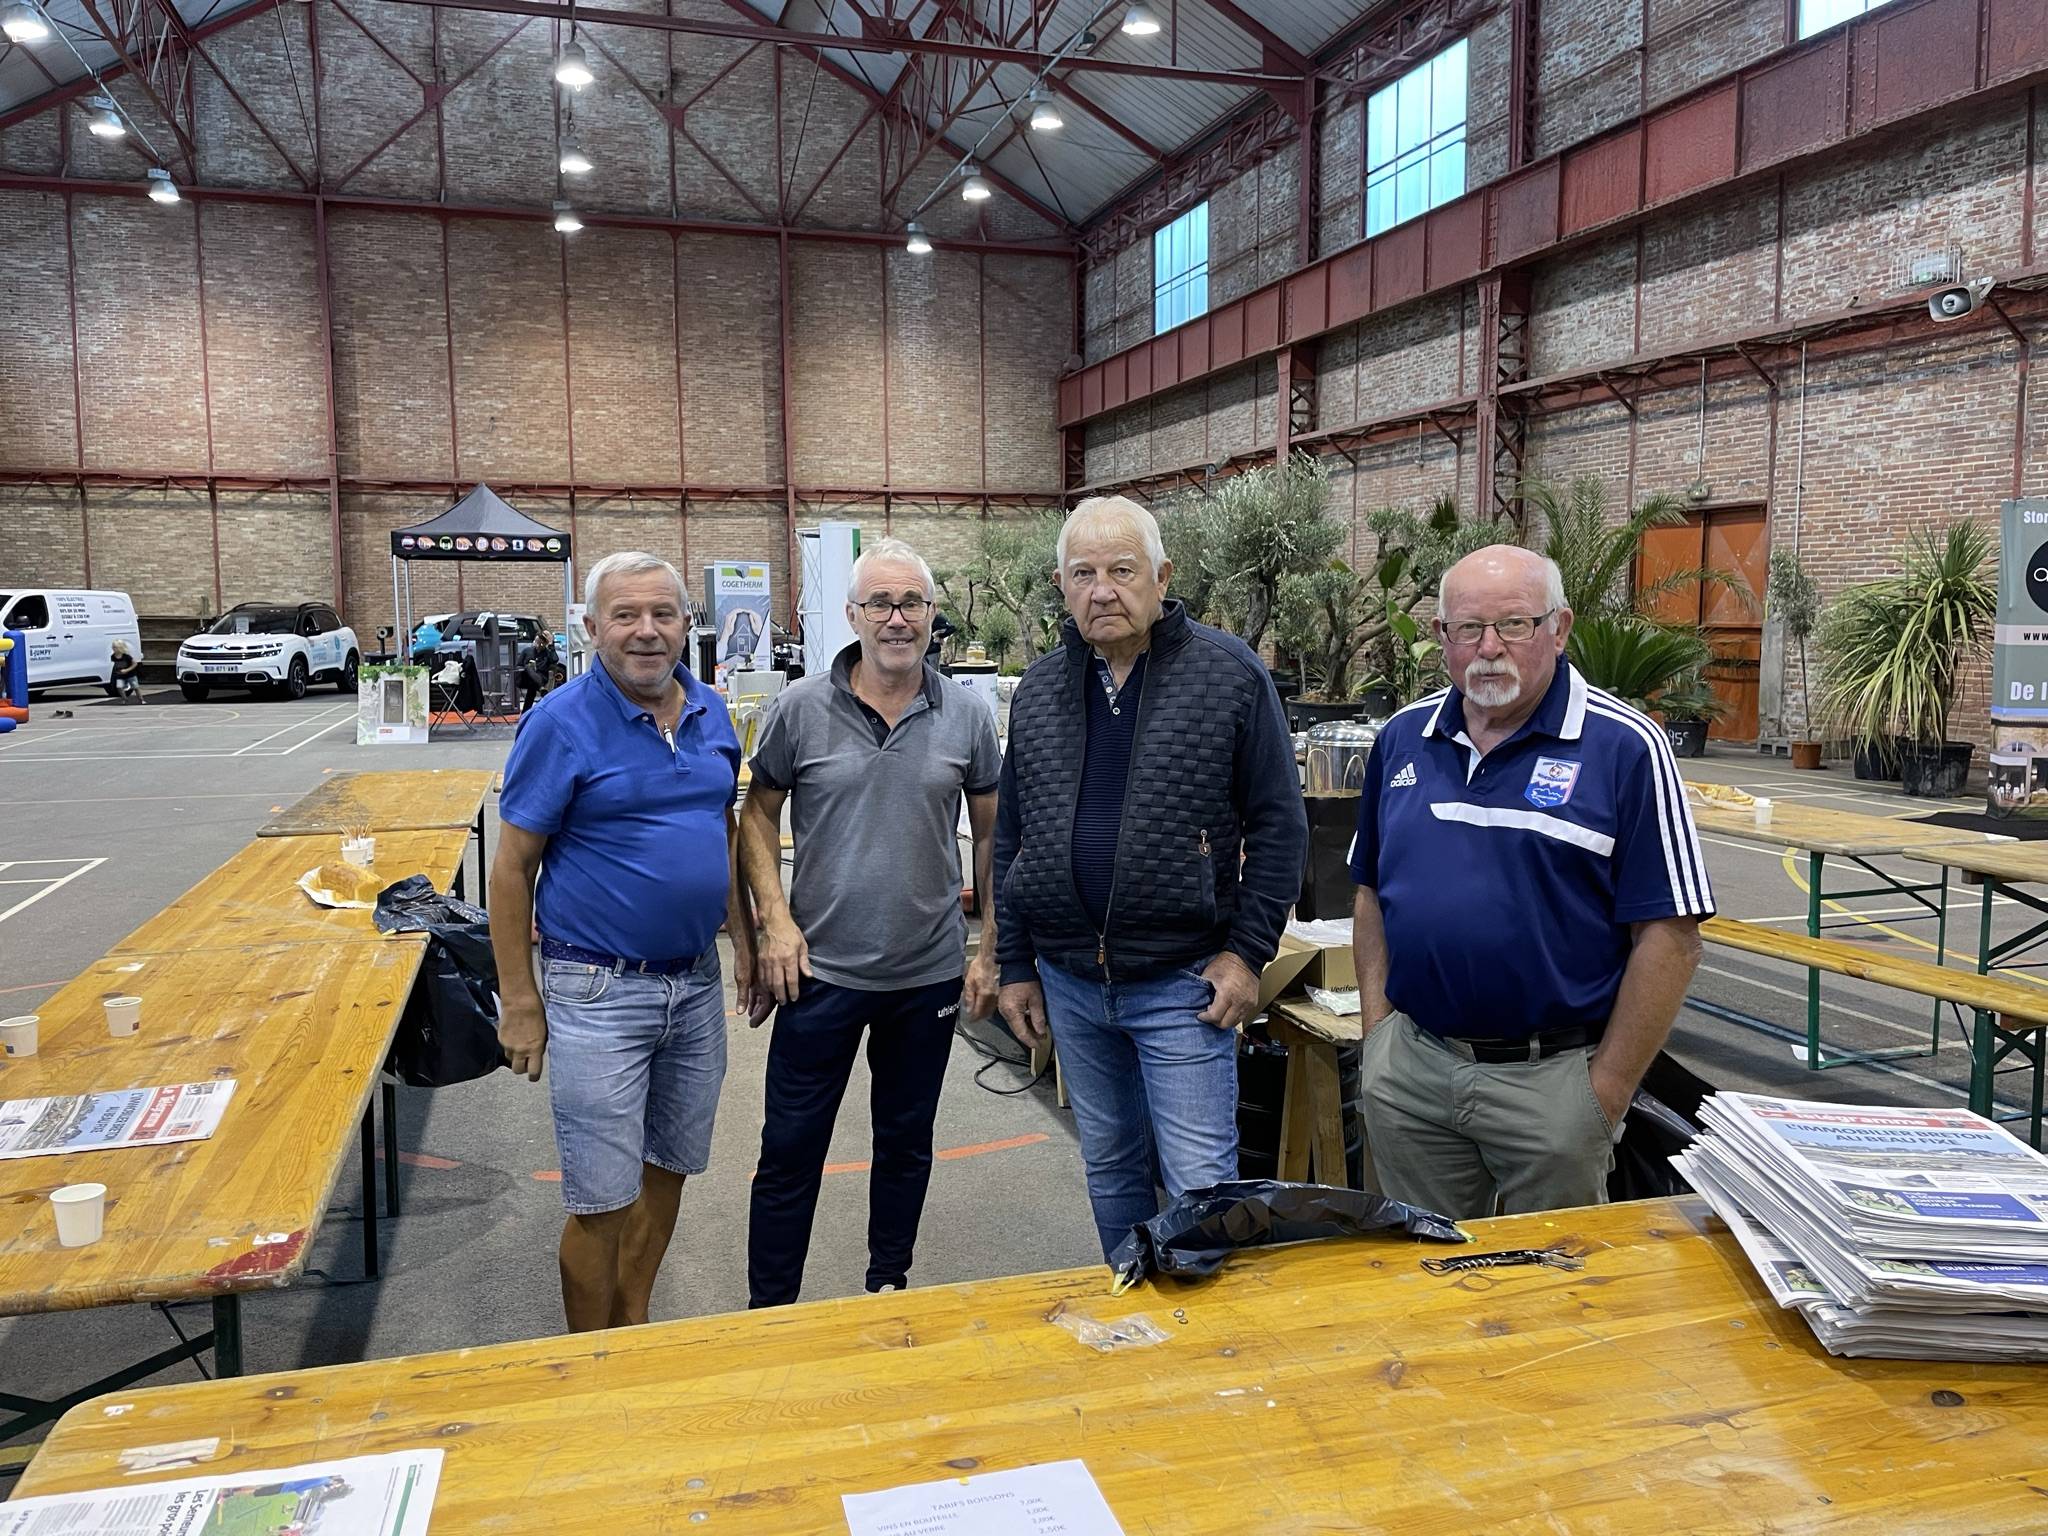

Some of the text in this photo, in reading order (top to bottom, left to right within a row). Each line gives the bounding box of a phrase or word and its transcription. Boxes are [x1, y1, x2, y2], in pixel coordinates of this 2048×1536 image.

[721, 580, 763, 589] COGETHERM
[2010, 681, 2035, 701] De
[1390, 777, 1417, 788] adidas
[103, 1093, 144, 1140] L'IMMOBILIER BRETON
[1794, 1112, 1929, 1126] Télégramme
[1785, 1123, 1993, 1140] L'IMMOBILIER BRETON
[174, 1491, 192, 1504] les
[192, 1489, 209, 1503] Les
[932, 1492, 1015, 1511] TARIFS BOISSONS
[165, 1504, 181, 1522] gros
[877, 1512, 959, 1532] VINS EN BOUTEILLE
